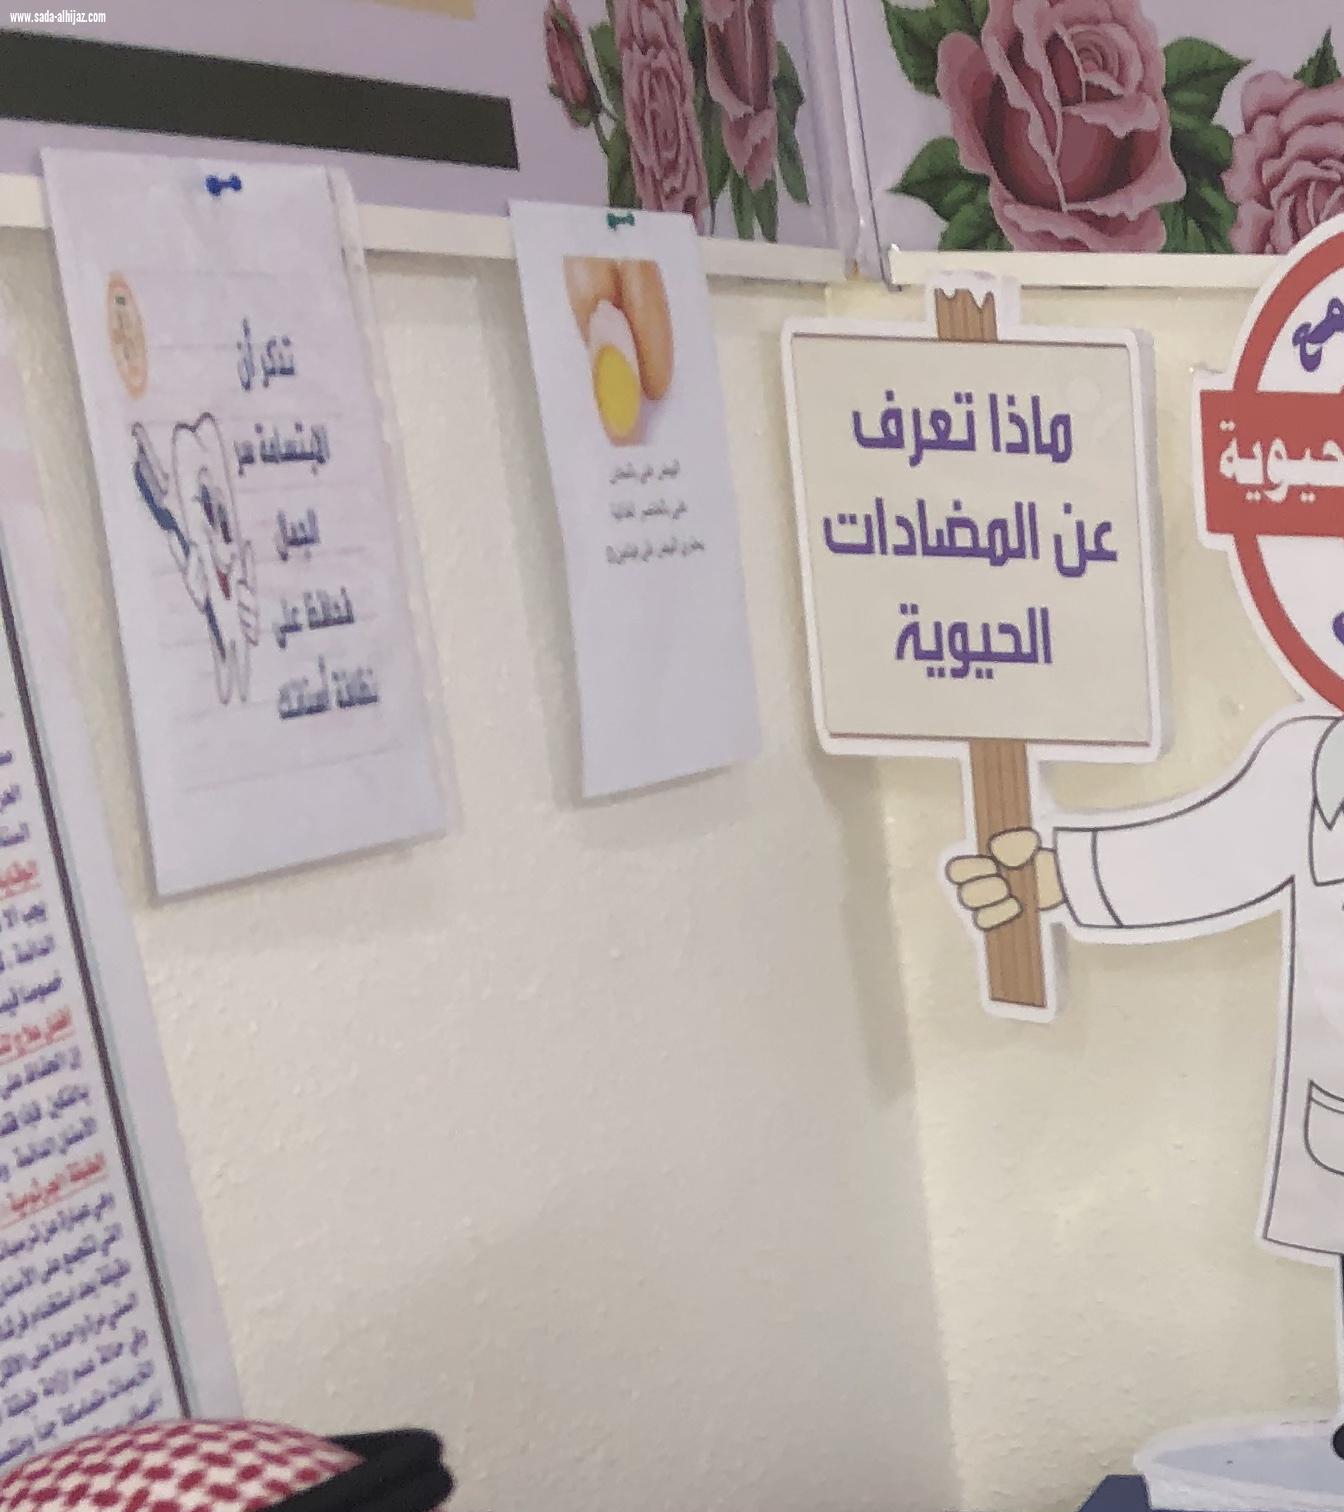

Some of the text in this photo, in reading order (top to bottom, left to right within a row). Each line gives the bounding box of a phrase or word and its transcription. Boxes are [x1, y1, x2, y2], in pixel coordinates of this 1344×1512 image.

[852, 390, 1073, 467] ماذا تعرف
[823, 497, 1118, 577] عن المضادات
[896, 603, 1053, 679] الحيوية
